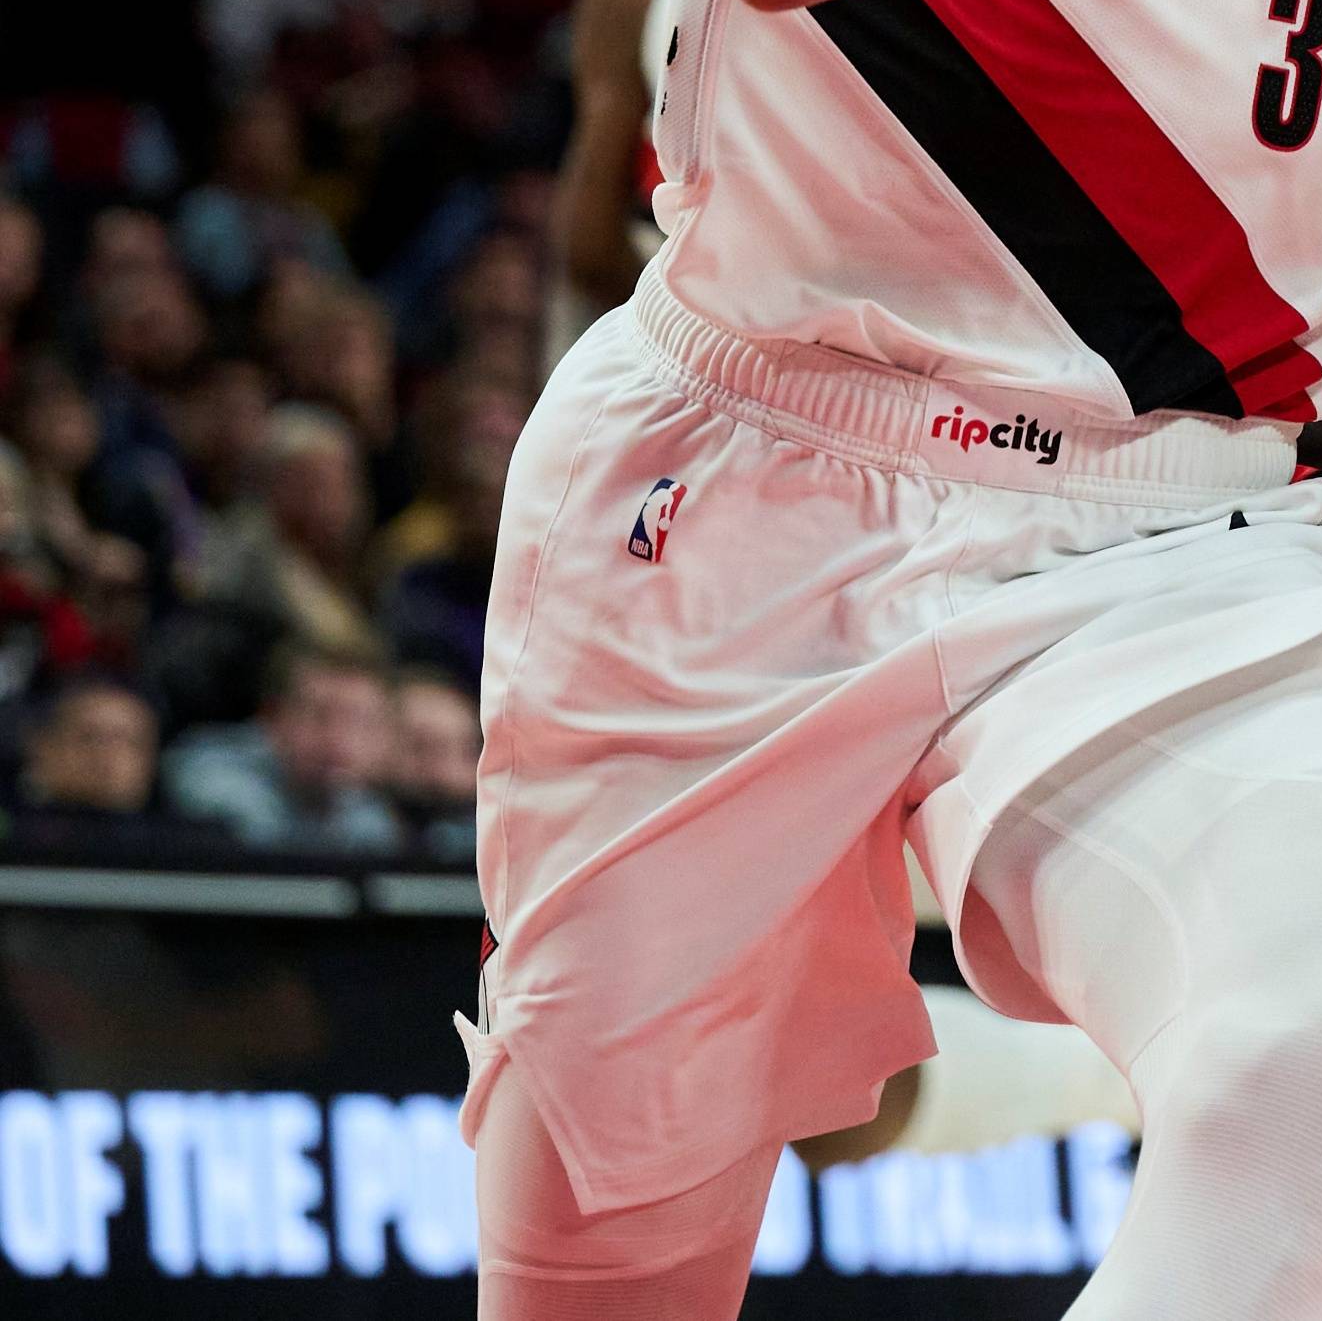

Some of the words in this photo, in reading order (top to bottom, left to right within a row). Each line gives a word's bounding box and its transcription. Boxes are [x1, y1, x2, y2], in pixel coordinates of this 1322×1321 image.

[630, 537, 650, 557] NBA
[0, 1090, 126, 1276] OF
[126, 1089, 330, 1276] THE
